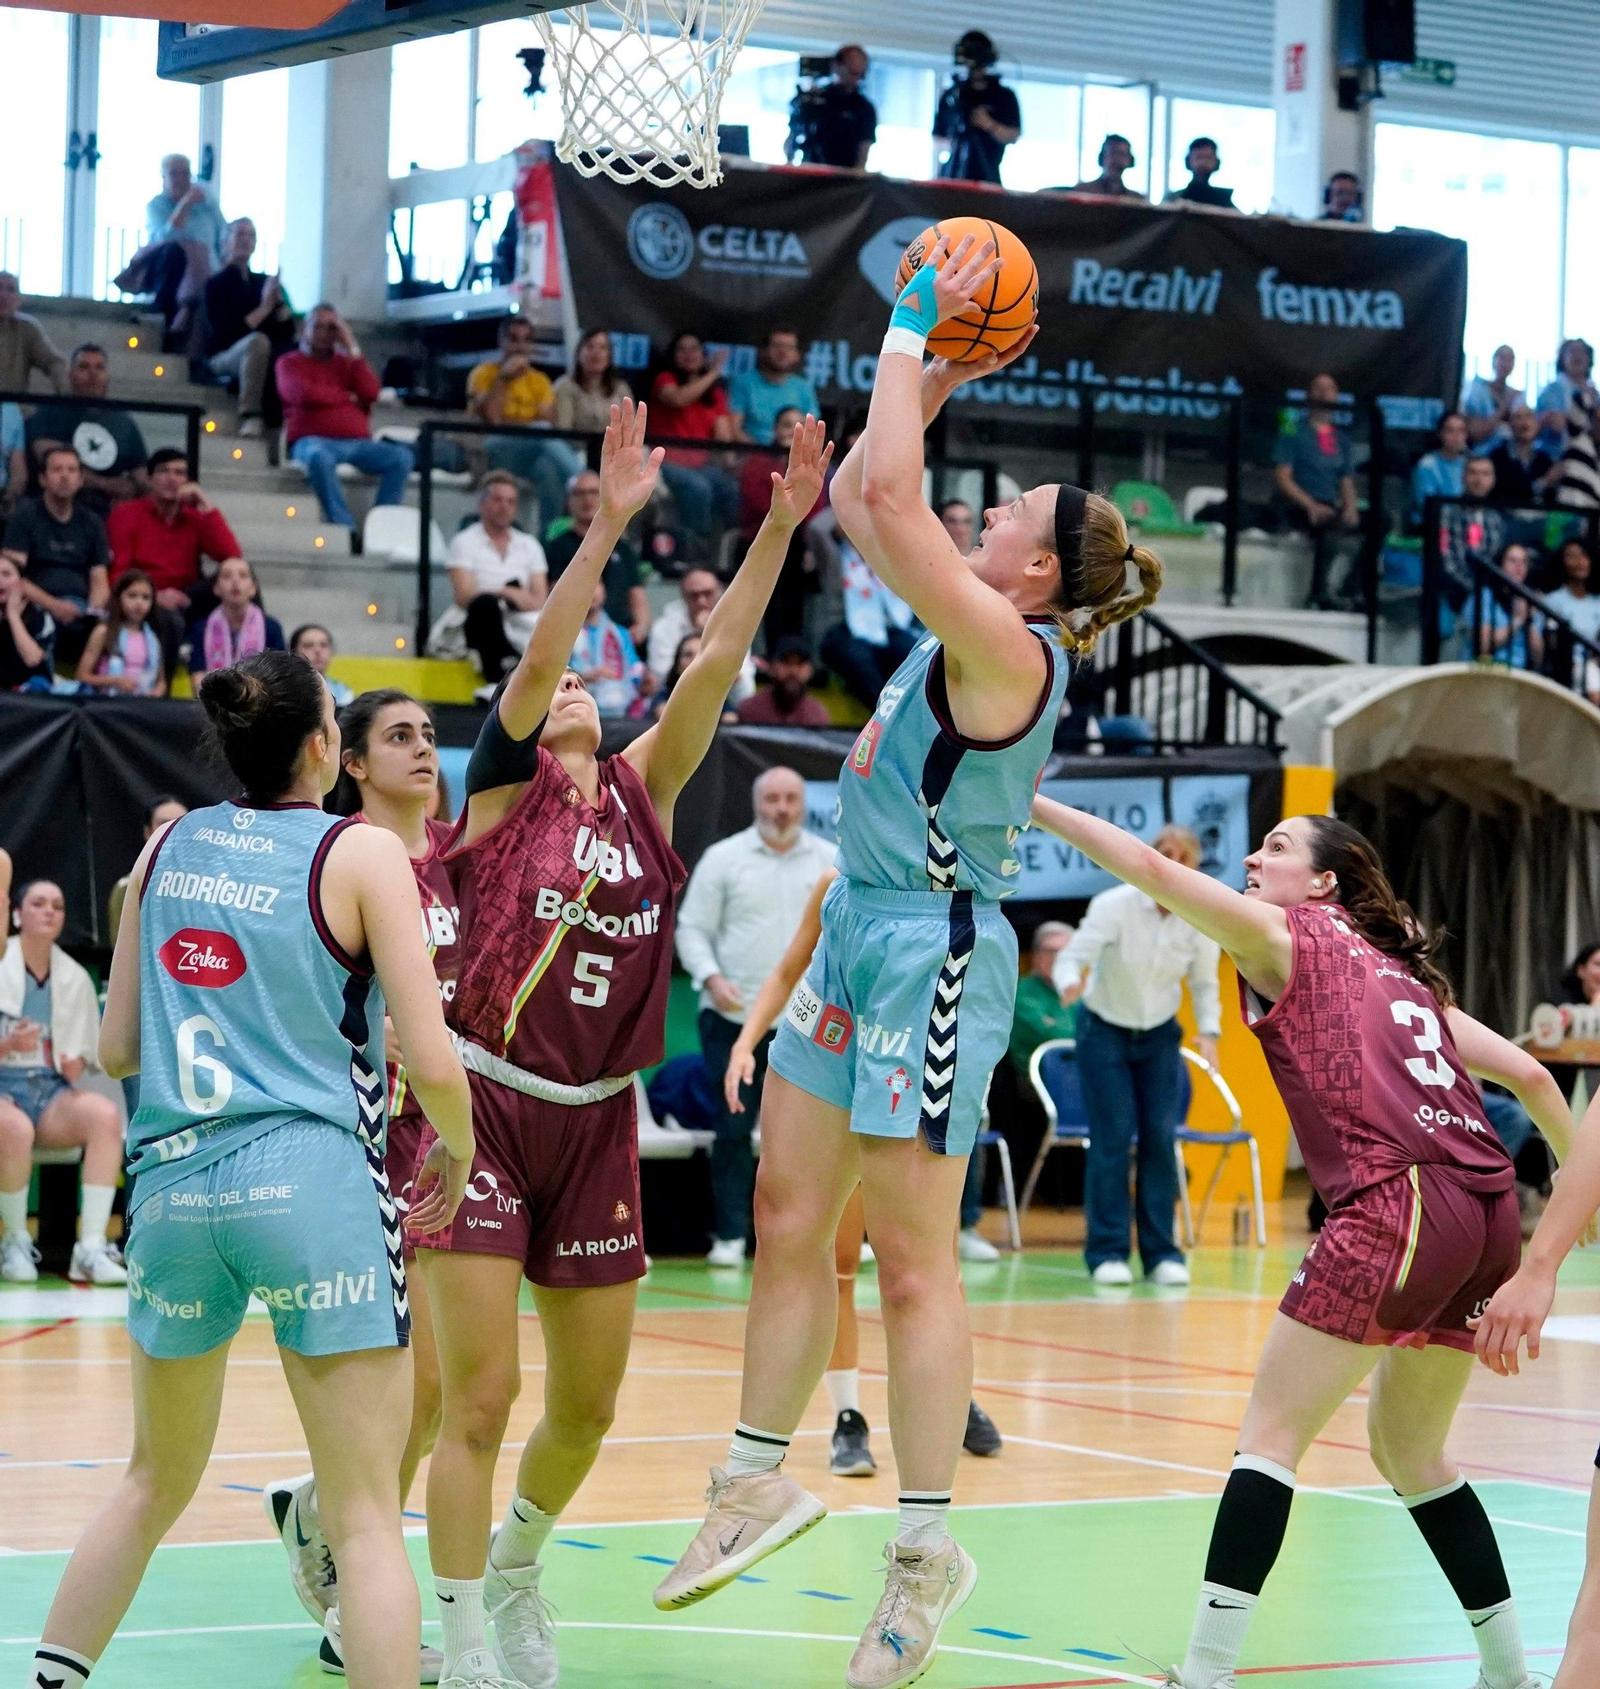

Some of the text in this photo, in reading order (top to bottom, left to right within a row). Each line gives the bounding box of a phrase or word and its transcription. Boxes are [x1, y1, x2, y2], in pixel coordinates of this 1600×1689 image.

[698, 223, 808, 263] CELTA
[1070, 258, 1223, 316] Recalvi
[1257, 267, 1405, 330] femxa
[156, 870, 280, 916] RODRÍGUEZ
[535, 887, 661, 938] Bosonit
[177, 938, 230, 974] Zorka
[570, 951, 614, 1008] 5
[177, 1014, 233, 1115] 6
[1389, 1000, 1457, 1091] 3
[169, 1213, 189, 1222] Global
[258, 1207, 292, 1216] Company
[170, 1185, 293, 1208] SAVINO DEL BENE
[495, 1189, 521, 1215] tvr
[479, 1219, 502, 1230] WIBO
[560, 1241, 584, 1256] LA
[586, 1232, 638, 1256] RIOJA
[252, 1266, 376, 1310] Recalvi
